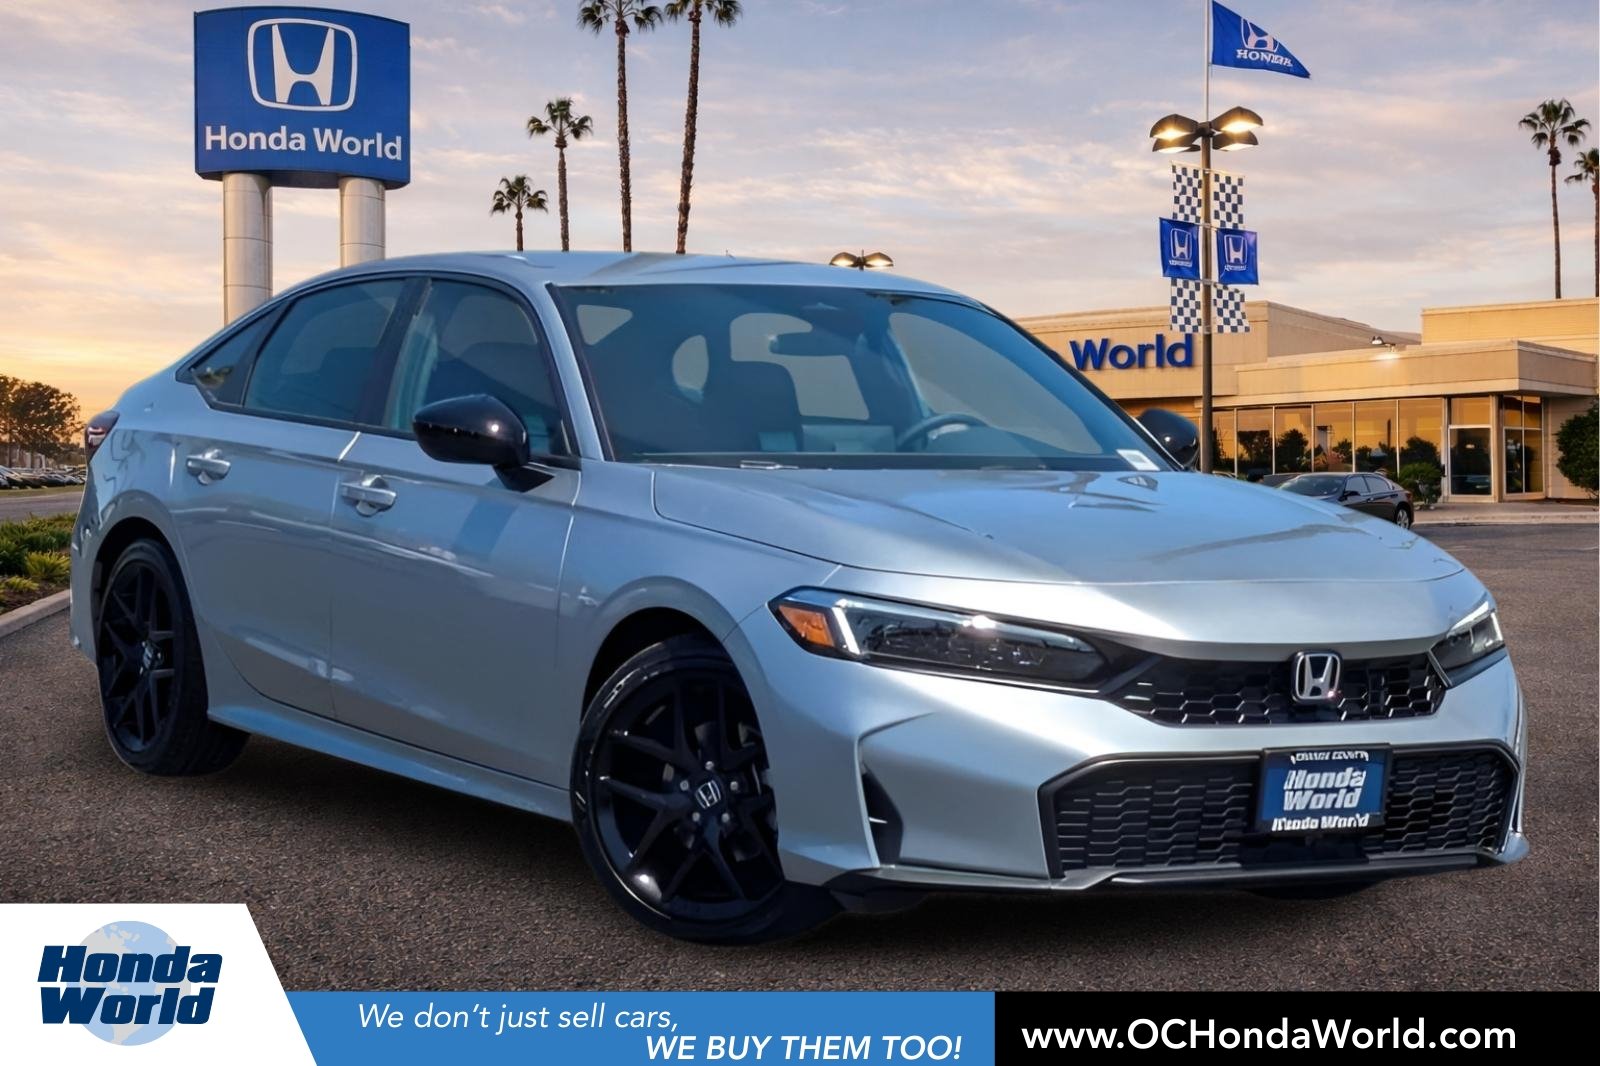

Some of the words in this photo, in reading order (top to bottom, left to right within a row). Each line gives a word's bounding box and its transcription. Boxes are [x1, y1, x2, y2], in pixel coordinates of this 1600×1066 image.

[205, 125, 306, 151] Honda
[313, 127, 402, 161] World
[1069, 333, 1193, 371] World
[1283, 767, 1367, 790] Honda
[1283, 788, 1362, 811] World
